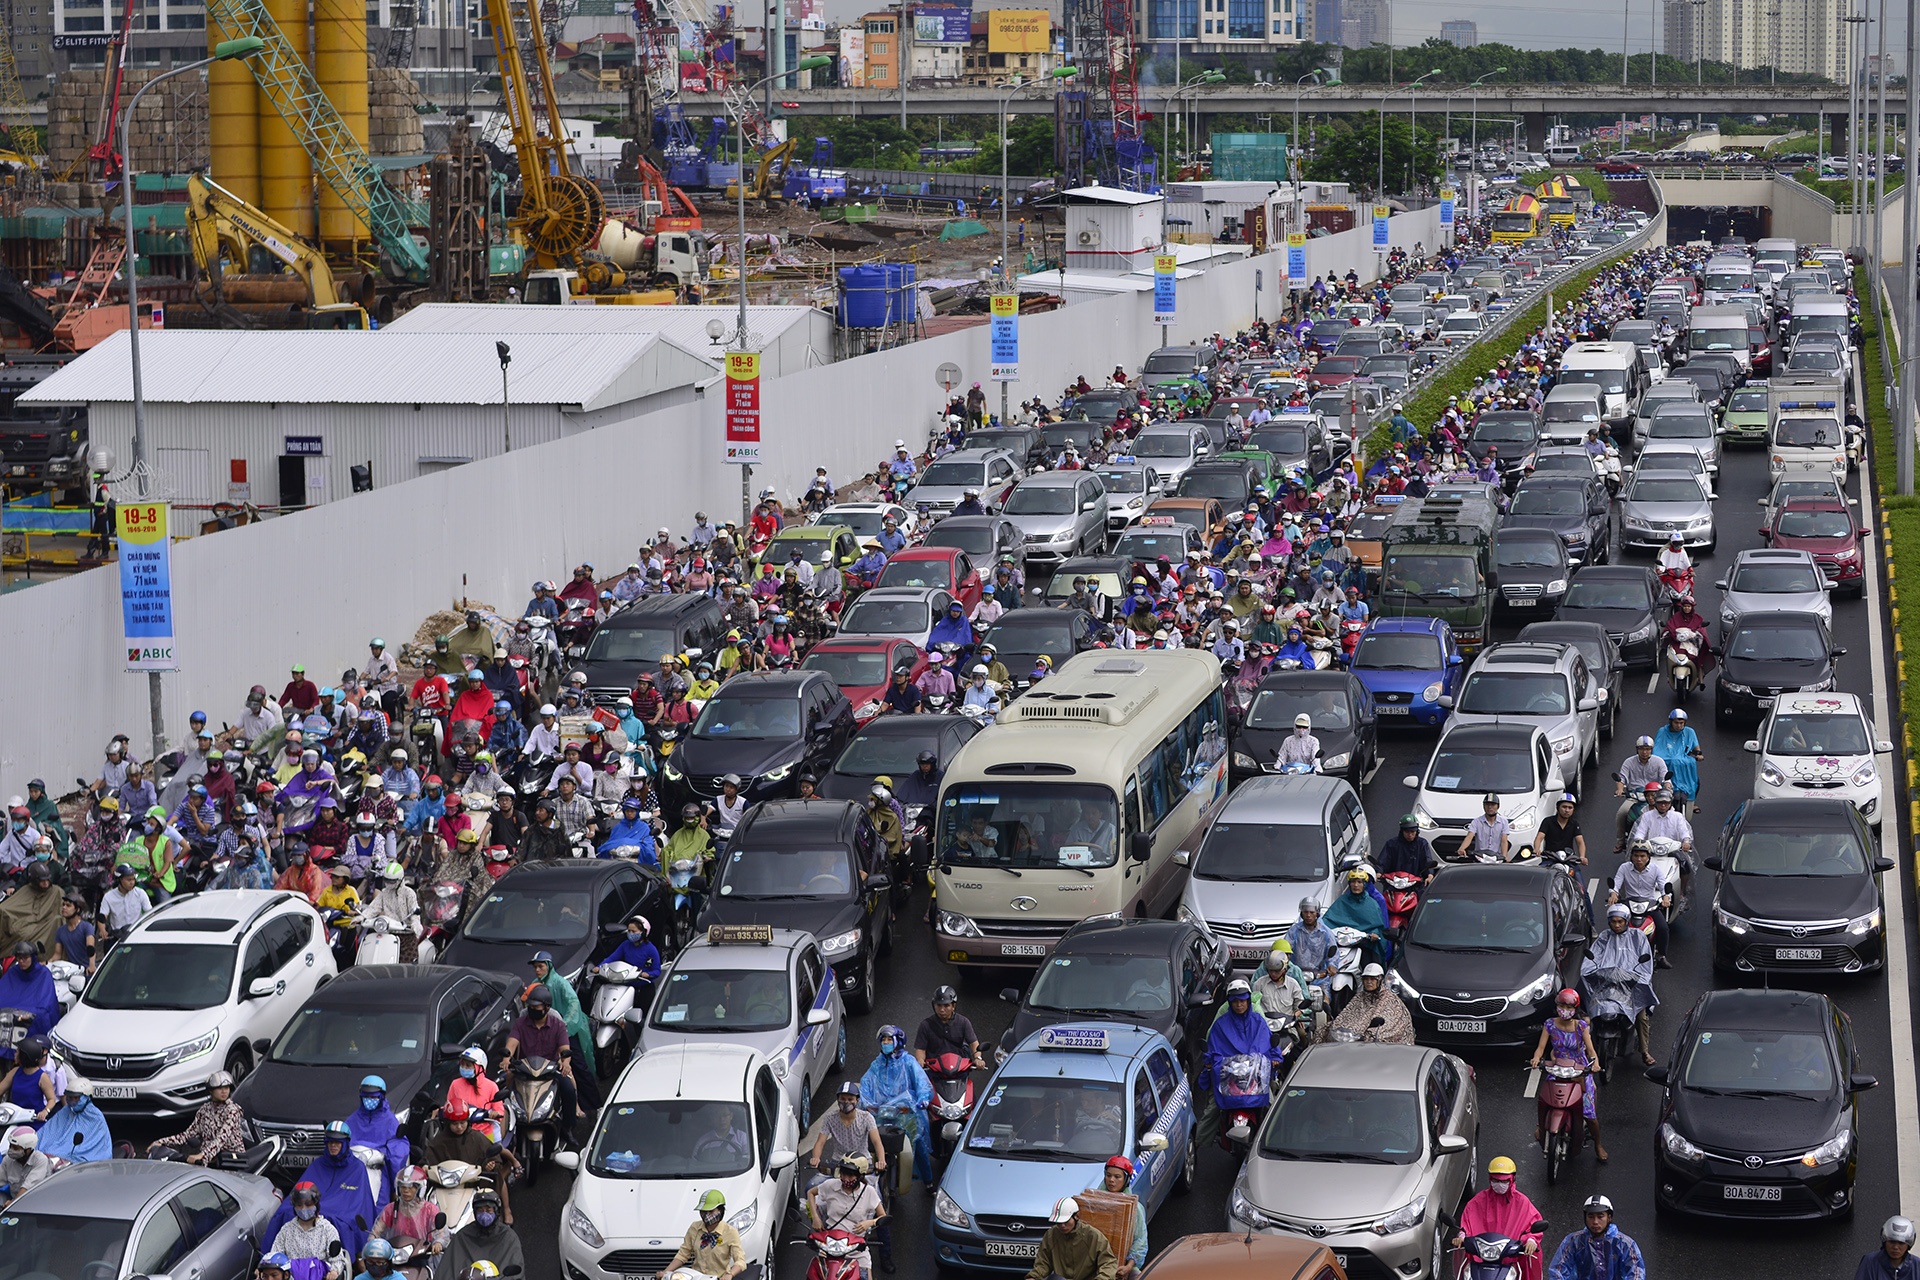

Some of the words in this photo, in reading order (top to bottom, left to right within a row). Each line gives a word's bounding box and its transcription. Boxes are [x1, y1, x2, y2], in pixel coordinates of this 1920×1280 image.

[230, 214, 267, 242] KOMATSU
[995, 298, 1012, 306] 19-8
[731, 357, 753, 367] 19-8
[287, 440, 302, 451] PHÒNG
[302, 442, 309, 451] AN
[310, 441, 321, 451] TOÀN
[123, 508, 157, 525] 19-8
[128, 552, 143, 562] CHÀO
[144, 552, 160, 561] MỪNG
[133, 563, 140, 574] KỶ
[142, 564, 157, 575] NIỆM
[134, 575, 143, 586] 71
[144, 576, 157, 586] NĂM
[124, 590, 138, 600] NGÀY
[140, 589, 154, 599] CÁCH
[156, 590, 170, 601] MẠNG
[132, 602, 150, 612] THÁNG
[151, 602, 164, 612] TÁM
[132, 614, 150, 624] THÀNH
[151, 614, 165, 623] CÔNG
[143, 648, 172, 659] ABIC
[737, 932, 768, 940] 935.935
[1003, 946, 1044, 955] 29B-155.10
[1778, 950, 1820, 958] 30E-164.32
[1439, 1021, 1484, 1031] 30A-078.31
[1725, 1187, 1780, 1200] 30A-847.68
